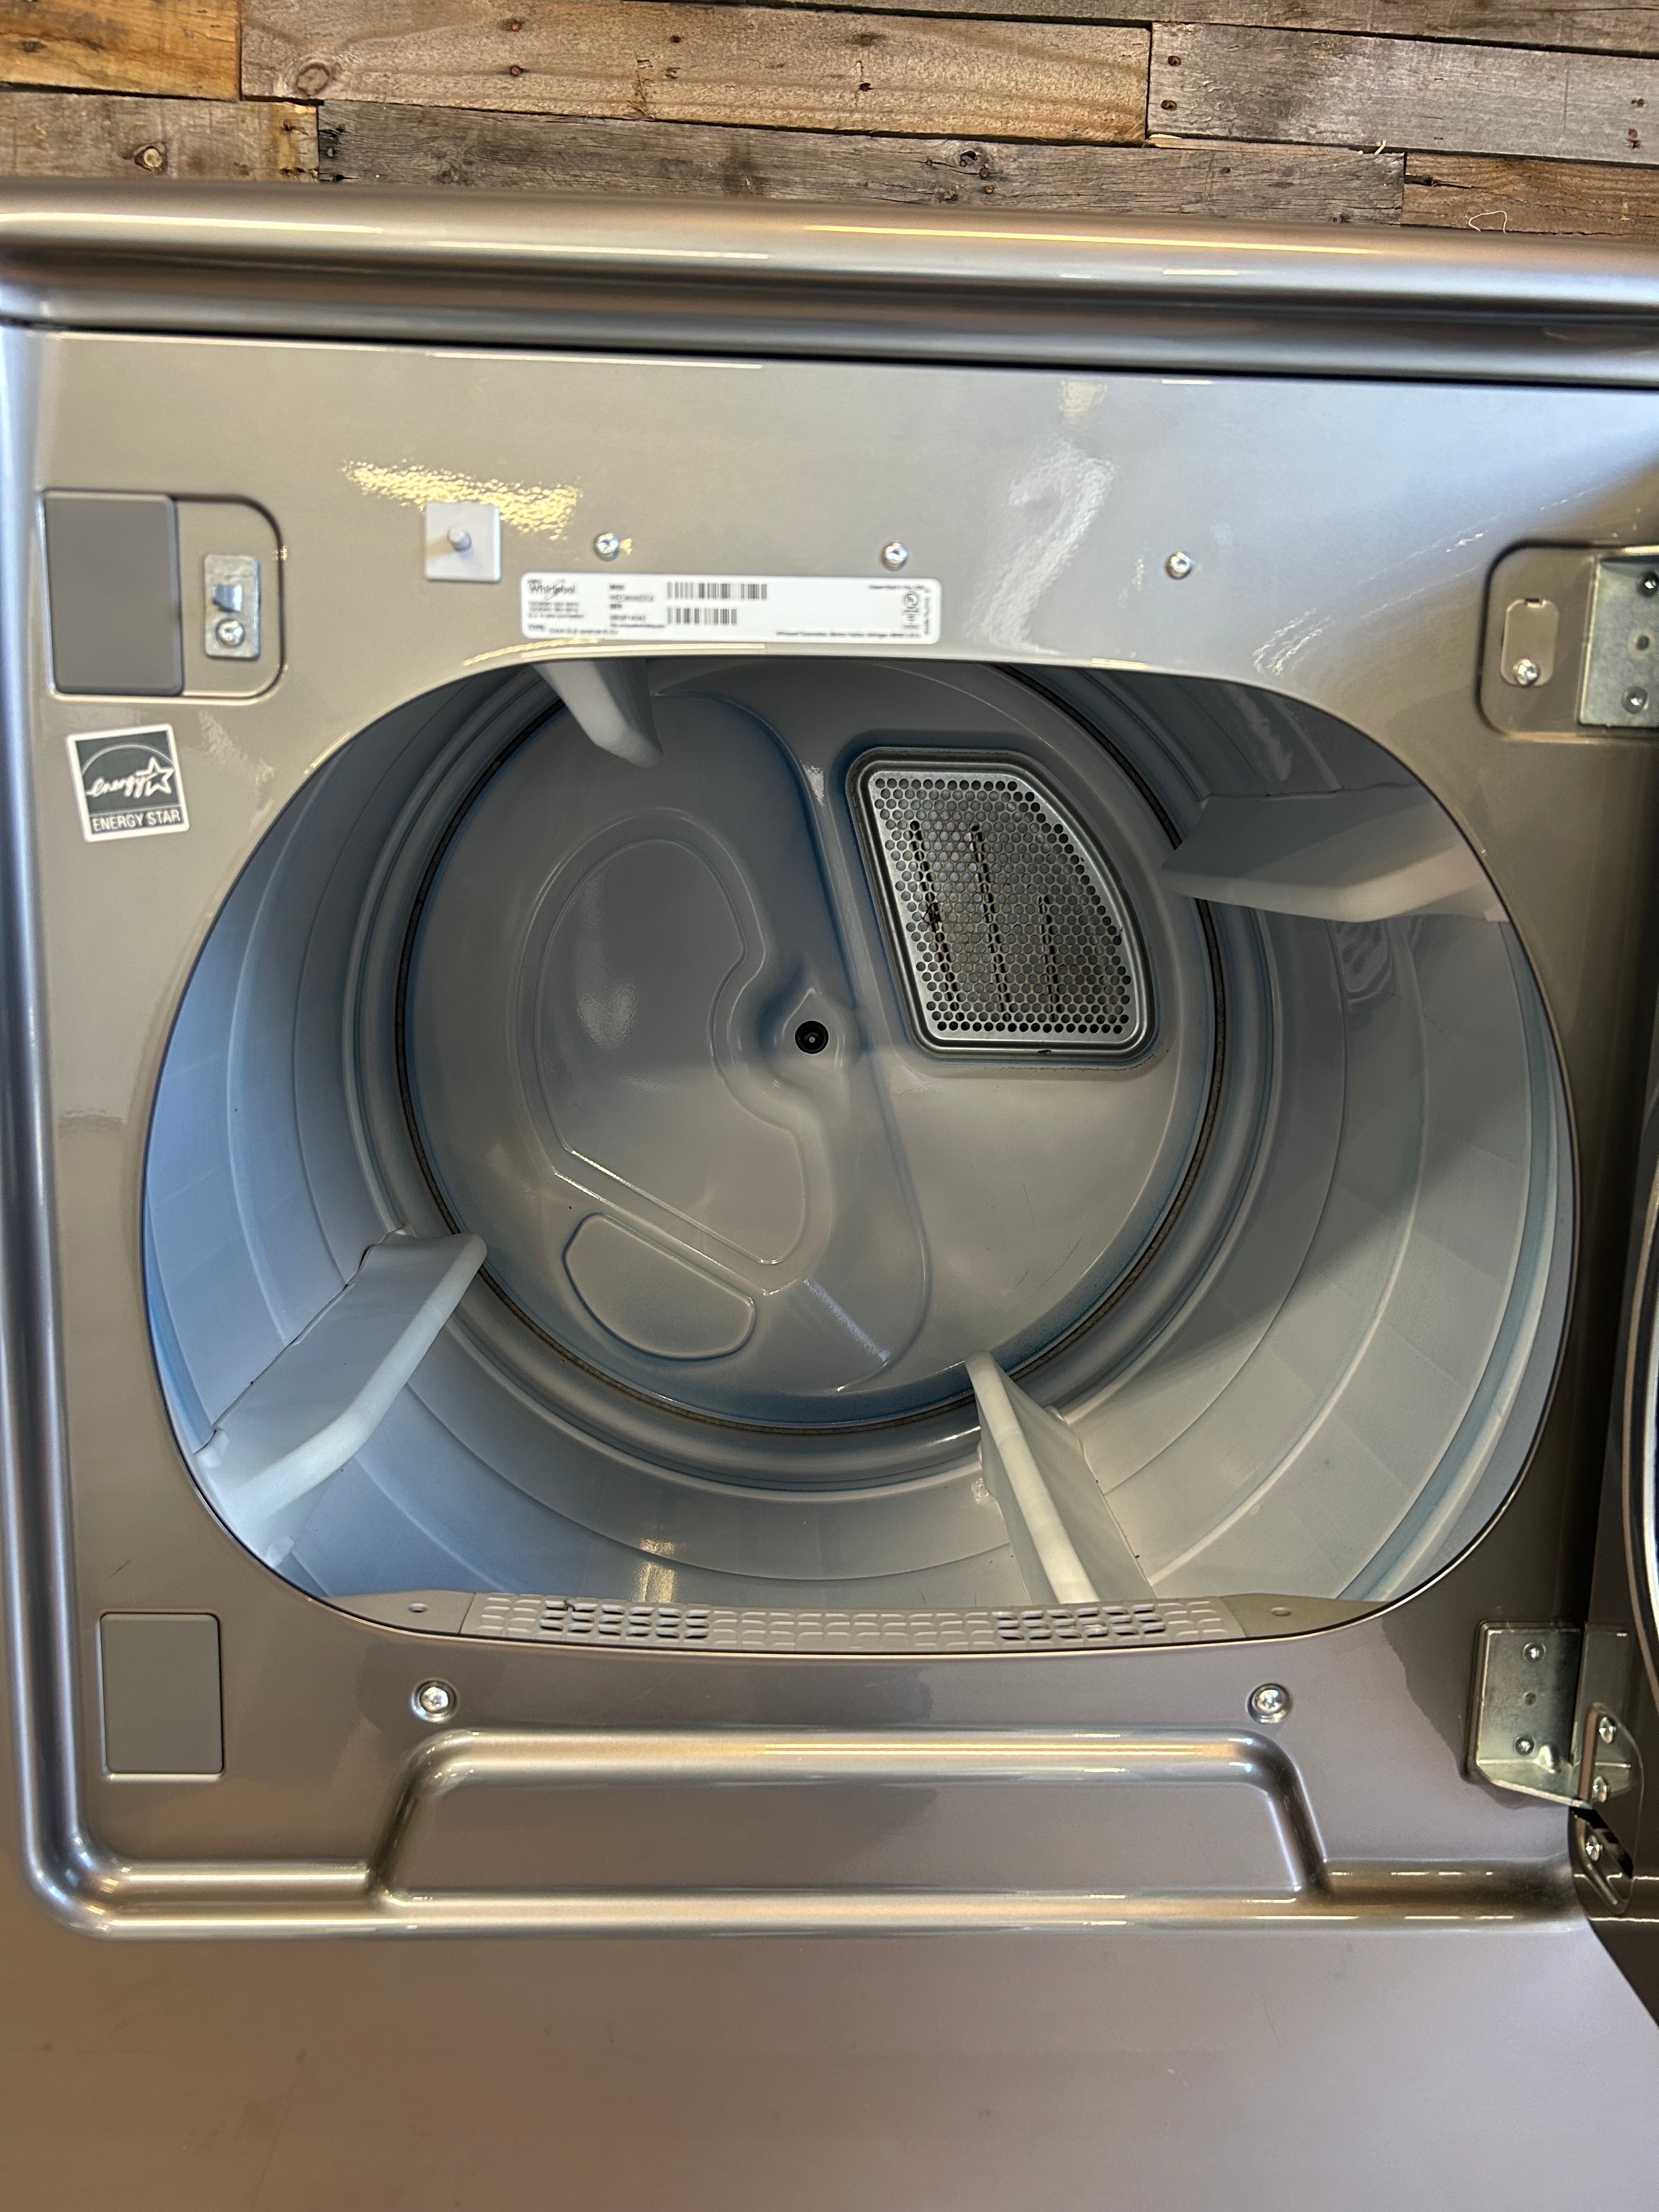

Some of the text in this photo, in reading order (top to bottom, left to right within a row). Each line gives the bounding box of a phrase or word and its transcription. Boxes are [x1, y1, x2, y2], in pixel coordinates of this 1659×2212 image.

[528, 580, 576, 598] Whirlpool
[93, 810, 180, 831] ENERGY STAR
